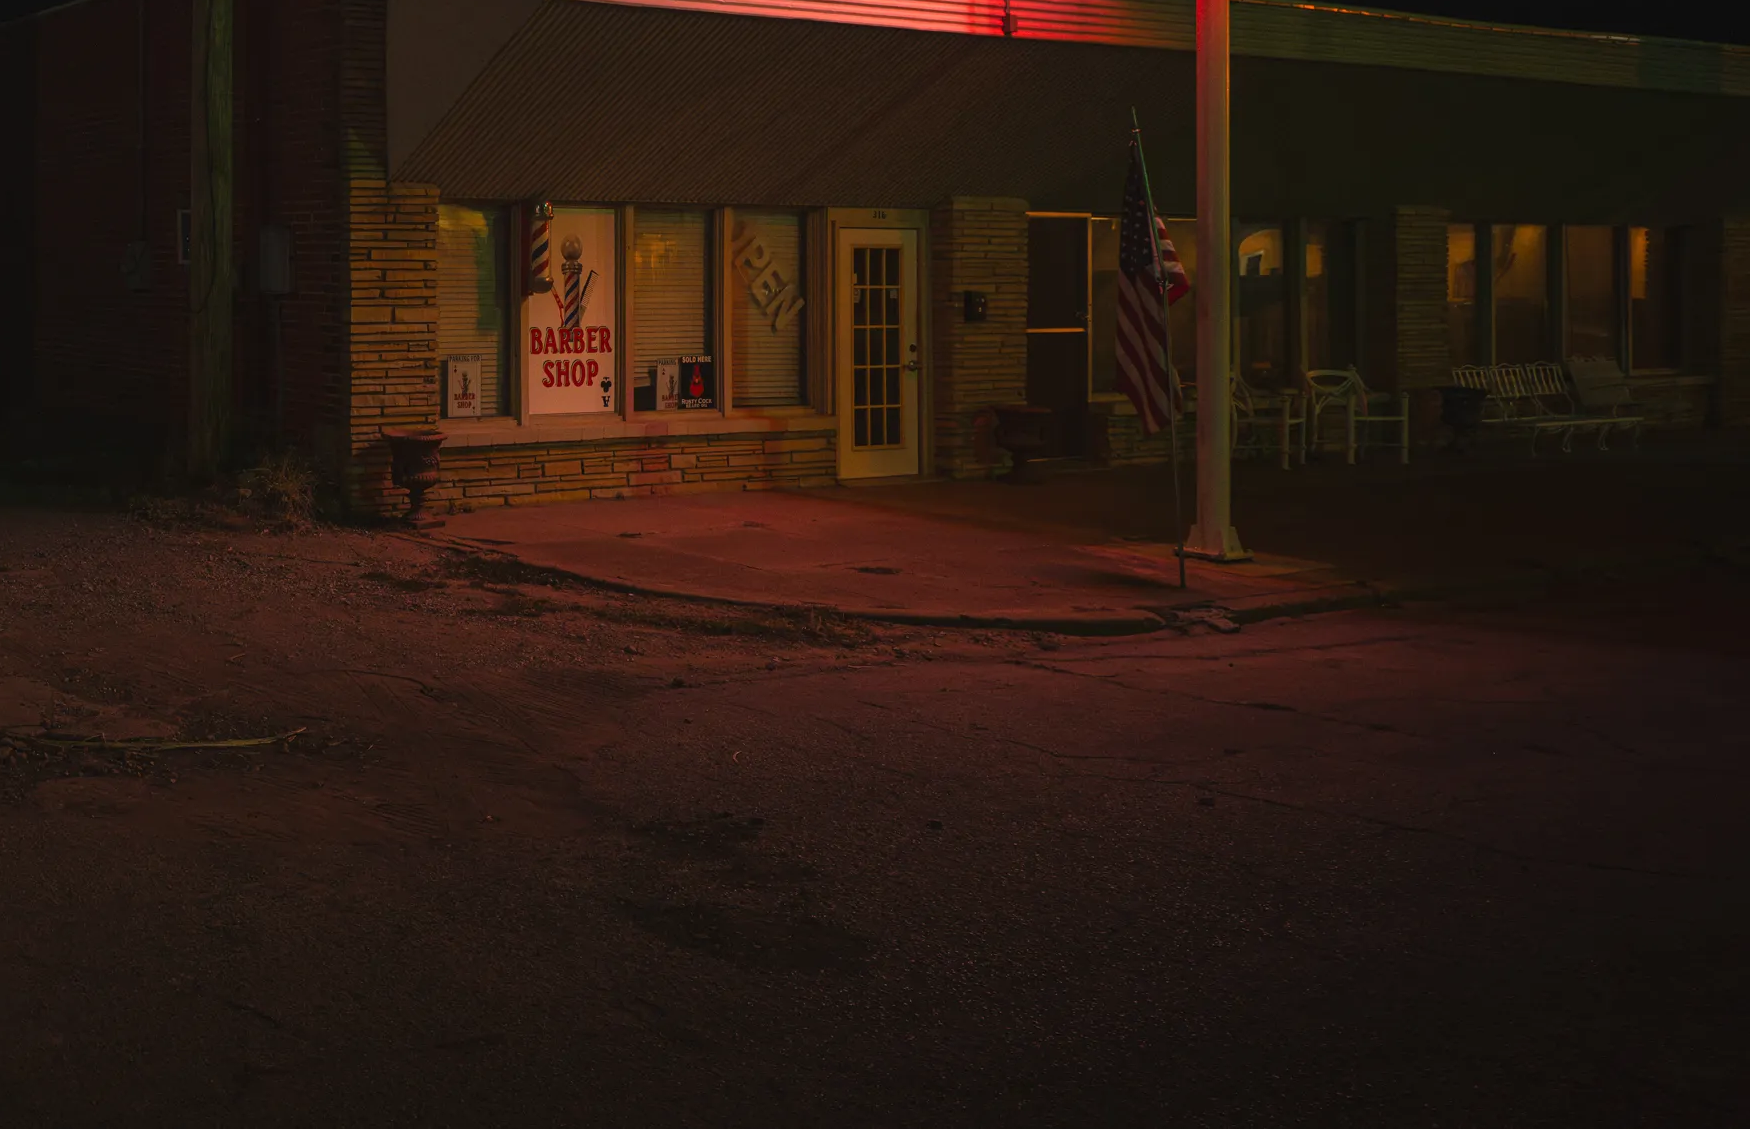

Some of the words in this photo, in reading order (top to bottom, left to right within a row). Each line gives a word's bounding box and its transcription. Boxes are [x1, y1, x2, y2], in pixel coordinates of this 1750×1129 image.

[872, 210, 887, 220] 316
[530, 326, 612, 354] BARBER
[698, 355, 712, 363] HERE
[542, 358, 599, 388] SHOP
[454, 393, 476, 401] BARBER
[457, 401, 472, 409] SHOP
